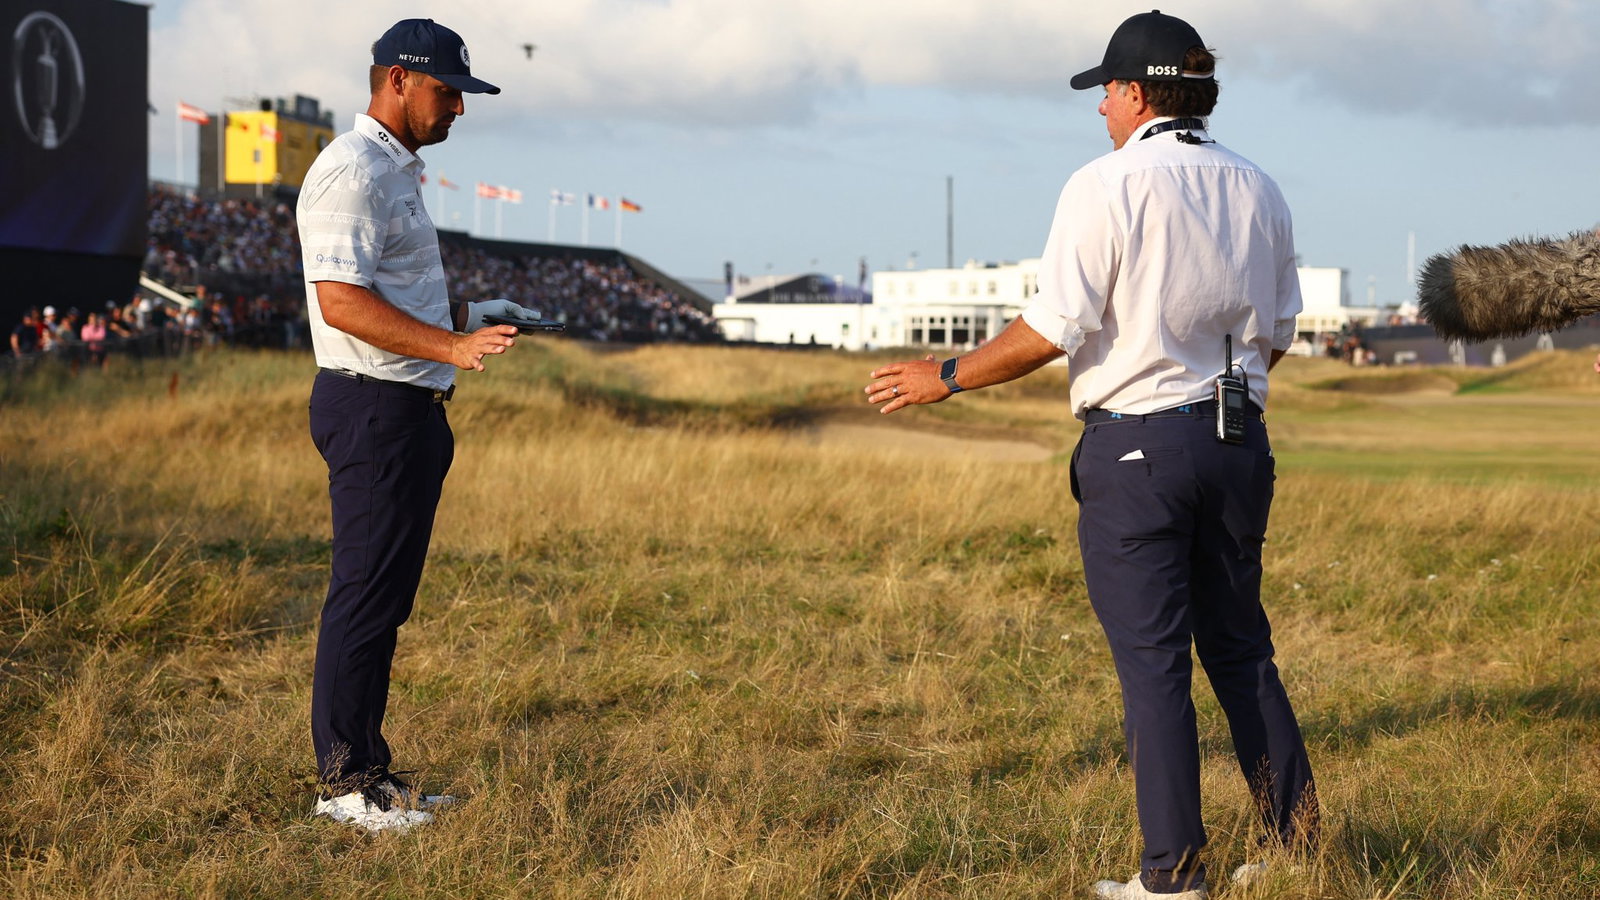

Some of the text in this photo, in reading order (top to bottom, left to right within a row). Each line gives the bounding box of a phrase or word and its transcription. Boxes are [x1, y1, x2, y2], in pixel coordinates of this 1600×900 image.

[398, 53, 430, 63] NETJETS
[1146, 65, 1178, 76] BOSS
[388, 142, 402, 157] HSBC
